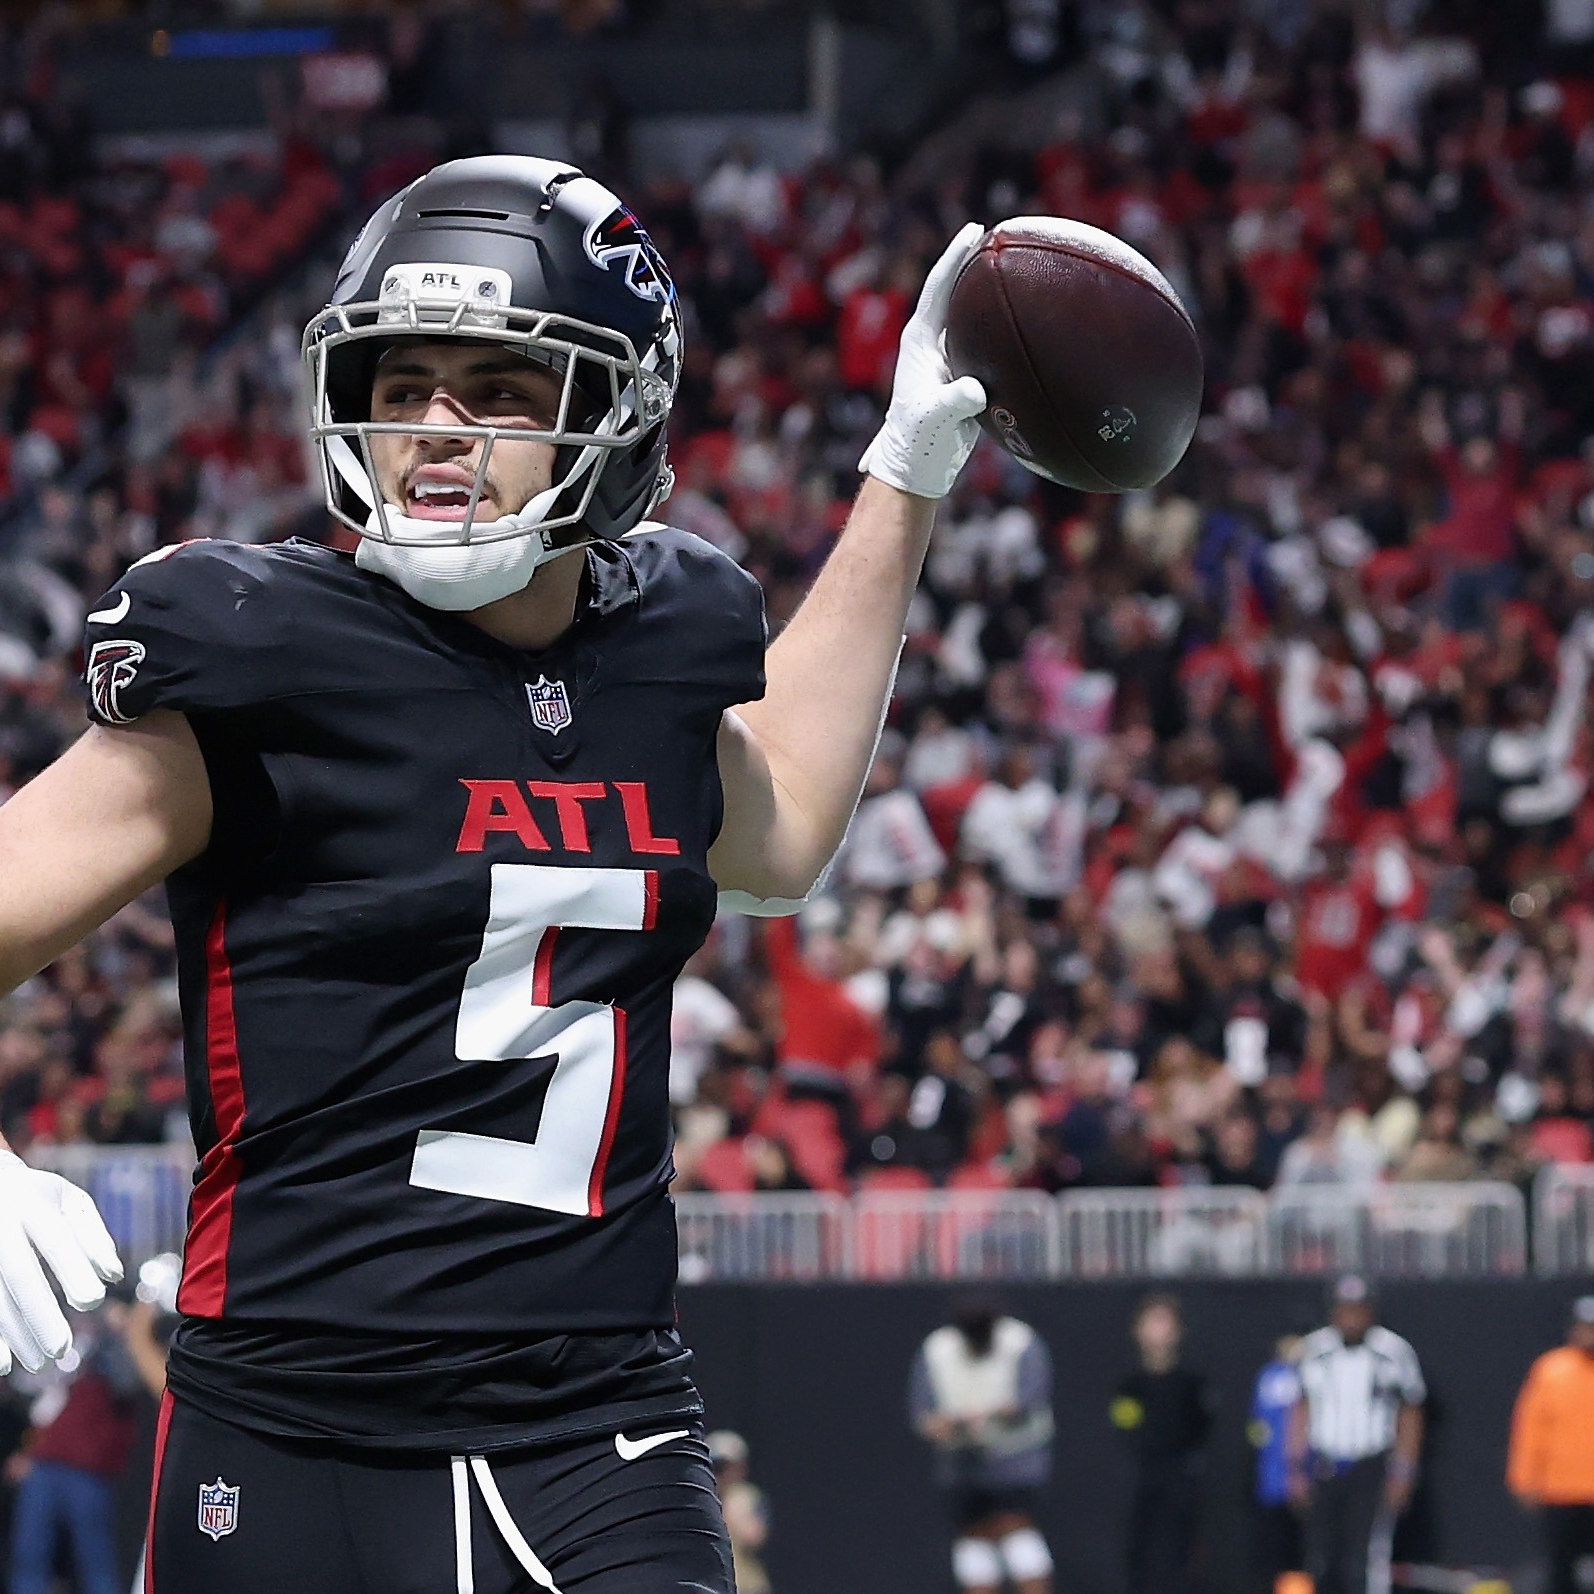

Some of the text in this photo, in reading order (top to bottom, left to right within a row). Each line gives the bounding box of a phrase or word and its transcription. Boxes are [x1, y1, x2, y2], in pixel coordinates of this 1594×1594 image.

[421, 272, 461, 289] ATL
[536, 701, 566, 723] NFL
[456, 778, 681, 854] ATL
[409, 863, 659, 1218] 5
[204, 1506, 231, 1530] NFL
